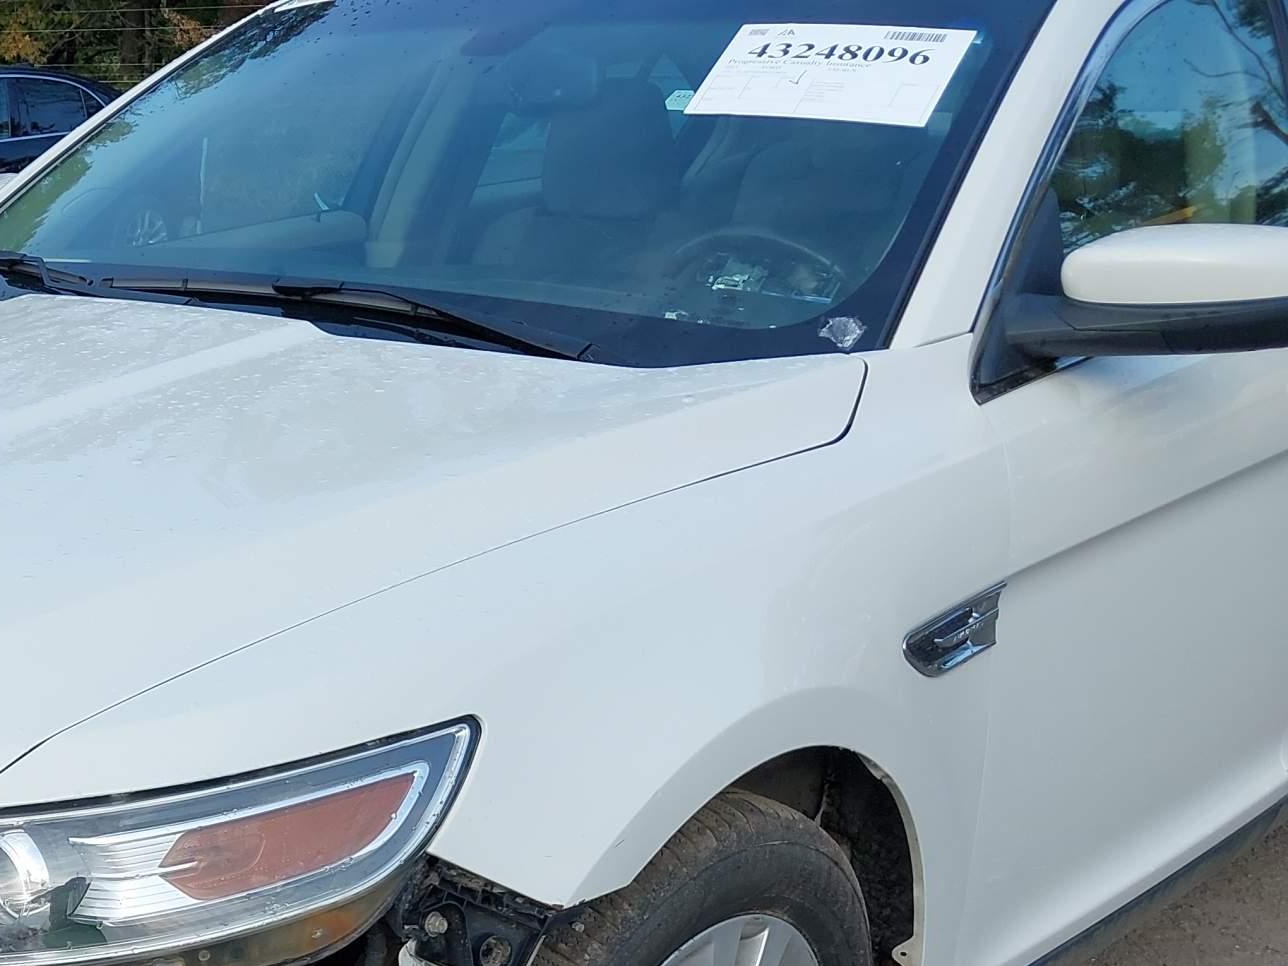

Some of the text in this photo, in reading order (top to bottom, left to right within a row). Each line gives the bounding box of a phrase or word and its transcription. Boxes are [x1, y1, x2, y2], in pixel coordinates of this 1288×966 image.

[748, 42, 936, 66] 43248096
[728, 58, 782, 66] Progressive
[826, 60, 873, 68] Insurance
